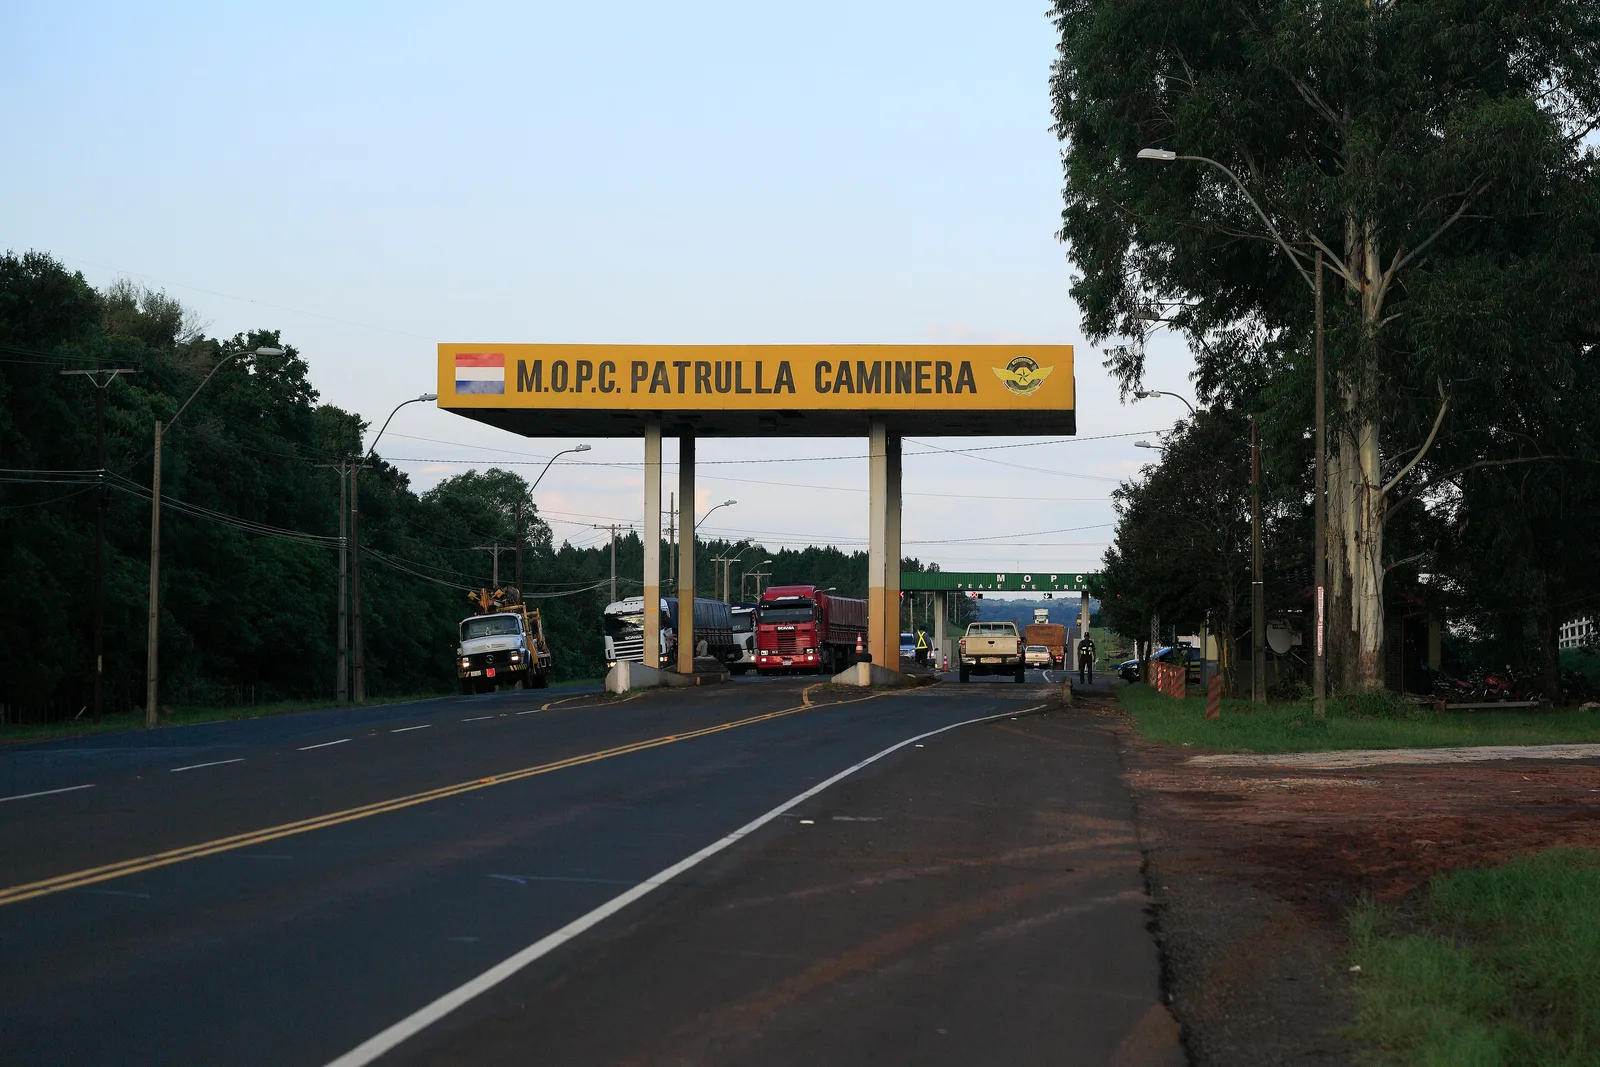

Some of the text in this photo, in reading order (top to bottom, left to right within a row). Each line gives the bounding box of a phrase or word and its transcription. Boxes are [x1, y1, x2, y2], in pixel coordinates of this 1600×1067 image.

[517, 360, 978, 394] M.O.P.C. PATRULLA CAMINERA
